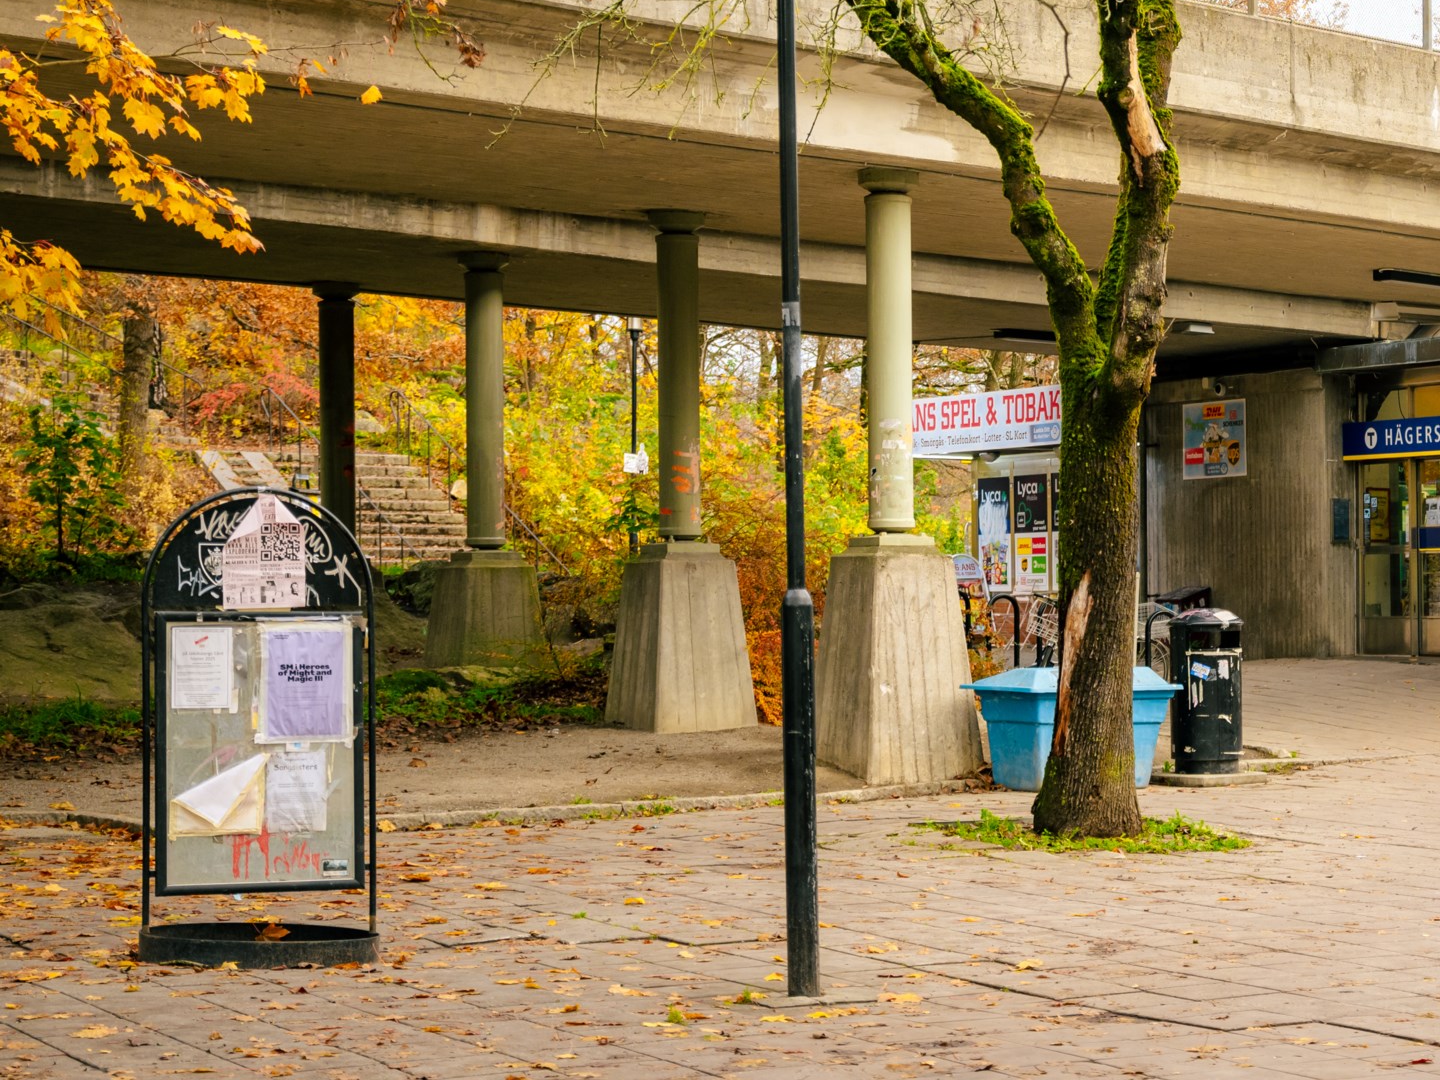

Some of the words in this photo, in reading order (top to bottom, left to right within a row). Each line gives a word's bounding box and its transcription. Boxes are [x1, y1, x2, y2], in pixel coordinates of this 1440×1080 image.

[912, 402, 936, 432] NS
[941, 398, 981, 430] SPEL
[986, 397, 997, 426] &
[1003, 390, 1060, 424] TOBAK
[921, 436, 944, 449] Smörgås
[948, 434, 981, 445] Telefonkort
[984, 431, 1002, 442] Lotter
[1006, 431, 1013, 440] SL
[1014, 430, 1027, 440] Kort
[981, 489, 1001, 502] Lyca
[1018, 481, 1038, 498] Lyca
